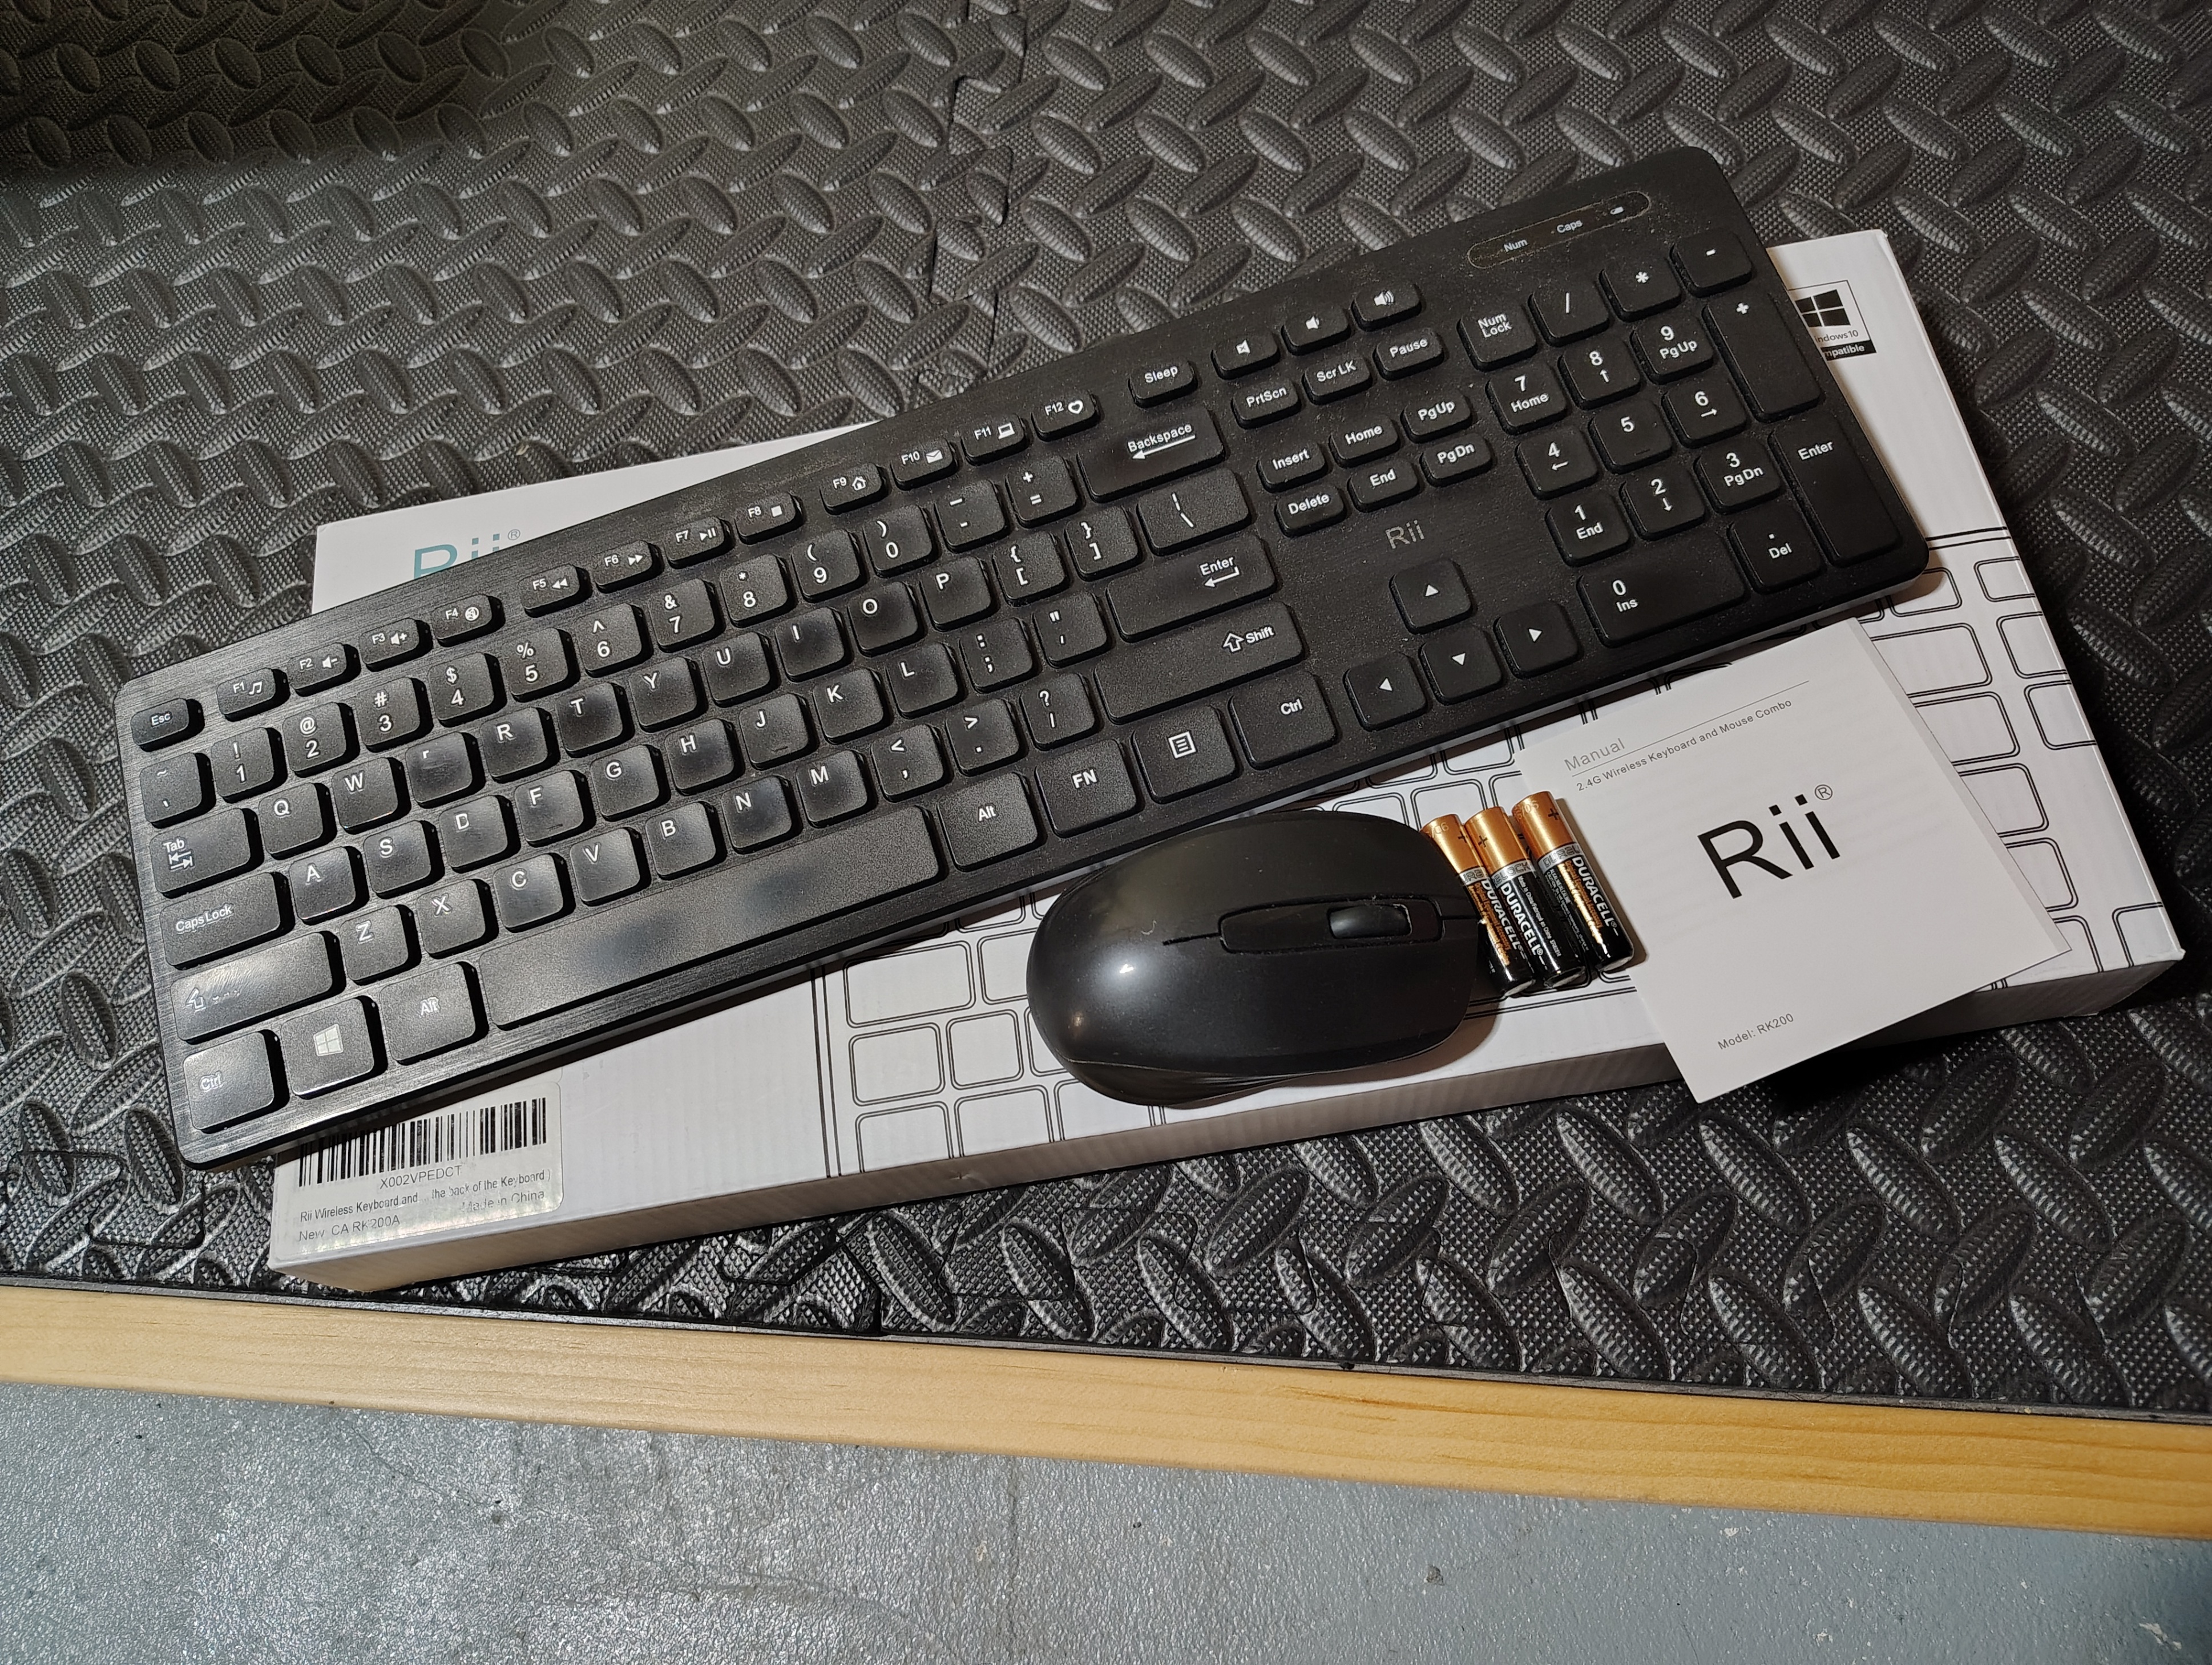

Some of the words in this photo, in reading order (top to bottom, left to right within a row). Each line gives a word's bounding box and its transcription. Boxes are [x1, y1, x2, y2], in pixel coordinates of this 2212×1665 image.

[1557, 220, 1583, 233] Caps
[1503, 239, 1528, 252] Num
[1478, 313, 1507, 329] Num
[1483, 321, 1511, 338] Lock
[1660, 326, 1674, 341] 9
[1814, 333, 1848, 342] indows
[1389, 339, 1428, 358] Pause
[1825, 345, 1865, 358] mpatible
[1589, 351, 1603, 366] 8
[1144, 366, 1178, 383] Sleep
[1515, 375, 1525, 391] 7
[1246, 387, 1287, 407] PrtScn
[1511, 394, 1548, 413] Home
[1694, 391, 1709, 406] 6
[1044, 402, 1064, 416] F12
[974, 426, 991, 440] F11
[1621, 417, 1634, 432] 5
[1127, 423, 1192, 452] Backspace
[1345, 426, 1382, 444] Home
[901, 451, 920, 465] F10
[1548, 442, 1560, 457] 4
[1798, 442, 1833, 460] Enter
[1272, 448, 1310, 470] Insert
[1726, 452, 1740, 468] 3
[833, 476, 847, 489] F9
[1370, 468, 1396, 487] End
[1651, 479, 1666, 495] 2
[748, 506, 762, 518] F8
[1288, 494, 1330, 515] Delete
[1575, 505, 1586, 520] 1
[675, 530, 688, 542] F7
[1385, 520, 1424, 549] Rii
[1576, 522, 1603, 539] End
[1768, 543, 1792, 559] Del
[604, 554, 619, 567] F6
[1200, 556, 1234, 575] Enter
[814, 567, 827, 583] 9
[935, 573, 949, 589] P
[532, 578, 546, 590] F5
[743, 591, 756, 608] 8
[862, 599, 878, 614] O
[1616, 599, 1638, 612] Ins
[445, 608, 459, 620] F4
[669, 616, 680, 633] 7
[372, 633, 385, 644] F3
[1245, 627, 1274, 643] Shift
[516, 642, 534, 658] %
[597, 641, 610, 657] 6
[716, 648, 731, 665] U
[299, 657, 313, 670] F2
[901, 662, 915, 677] L
[446, 666, 457, 684] $
[526, 664, 538, 682] 5
[644, 672, 657, 689] Y
[233, 681, 245, 693] F1
[826, 685, 843, 702] K
[374, 691, 387, 707] #
[451, 689, 464, 705] 4
[569, 698, 583, 714] T
[1281, 698, 1303, 715] Ctrl
[151, 713, 171, 726] Esc
[300, 717, 316, 734] @
[379, 715, 391, 732] 3
[756, 711, 766, 728] J
[497, 724, 513, 741] R
[306, 740, 319, 758] 2
[680, 734, 696, 753] H
[1576, 774, 1602, 791] 2.4G
[1603, 756, 1648, 779] Wireless
[1648, 737, 1697, 763] Keyboard
[1699, 728, 1718, 745] and
[1719, 714, 1754, 733] Mouse
[1755, 699, 1793, 719] Combo
[1564, 738, 1626, 771] Manual
[236, 765, 245, 782] 1
[606, 762, 622, 779] G
[810, 766, 829, 785] M
[1072, 769, 1097, 789] FN
[344, 772, 363, 792] W
[530, 787, 542, 805] F
[735, 792, 752, 811] N
[273, 800, 290, 817] Q
[979, 805, 996, 822] Alt
[455, 813, 470, 830] D
[661, 820, 676, 837] B
[163, 838, 185, 853] Tab
[380, 839, 393, 859] S
[583, 844, 599, 864] V
[306, 864, 322, 882] A
[1565, 859, 1577, 879] Original
[512, 871, 527, 887] C
[431, 896, 451, 915] X
[355, 920, 373, 944] Z
[1717, 1029, 1756, 1049] Model:
[1756, 1013, 1794, 1035] RK200
[200, 1071, 224, 1093] Ctrl
[380, 1165, 462, 1189] X002VPEDCT
[300, 1211, 312, 1222] Rii
[315, 1205, 353, 1220] Wireless
[356, 1196, 398, 1213] Keyboard
[401, 1193, 418, 1204] and
[473, 1181, 482, 1192] of
[484, 1179, 497, 1190] the
[511, 1191, 544, 1203] China
[332, 1223, 349, 1236] CA
